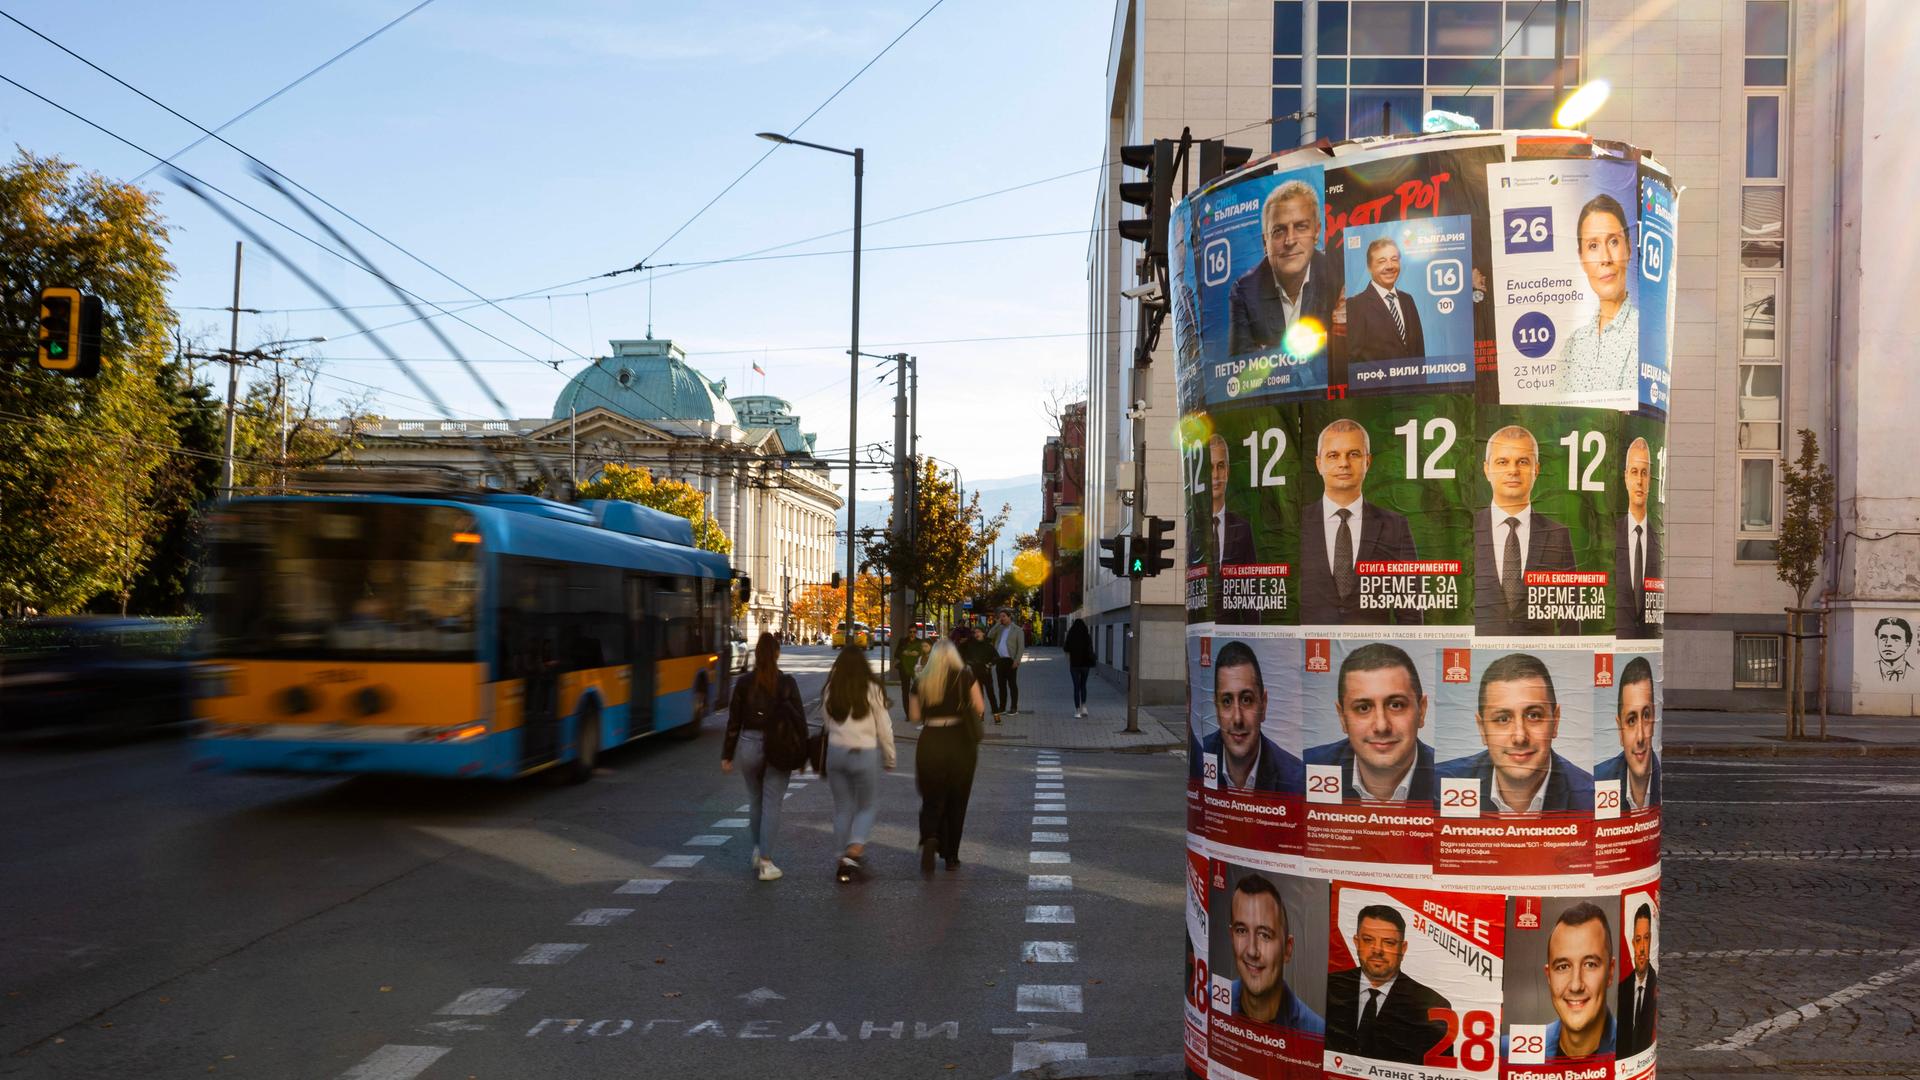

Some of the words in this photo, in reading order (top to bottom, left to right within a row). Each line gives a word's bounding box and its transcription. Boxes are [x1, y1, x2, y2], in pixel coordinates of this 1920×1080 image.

[1329, 184, 1344, 194] РУСЕ
[1215, 199, 1259, 221] БЪЛГАРИЯ
[1509, 217, 1549, 243] 26
[1209, 253, 1224, 274] 16
[1648, 244, 1660, 269] 16
[1434, 268, 1457, 286] 16
[1506, 278, 1573, 291] Елисавета
[1507, 292, 1584, 305] Белобрадова
[1519, 327, 1550, 343] 110
[1215, 360, 1246, 377] ПЕТЪР
[1249, 352, 1309, 371] МОСКОВ
[1357, 369, 1387, 381] проф.
[1390, 366, 1419, 377] ВИЛИ
[1421, 362, 1466, 375] ЛИЛКОВ
[1513, 366, 1529, 377] 23
[1531, 364, 1557, 375] МИР
[1228, 381, 1239, 392] 101
[1267, 374, 1290, 386] СОФИЯ
[1517, 379, 1555, 390] София
[1394, 417, 1457, 480] 12
[1243, 427, 1287, 488] 12
[1560, 430, 1607, 492] 12
[1223, 567, 1237, 576] СТИГА
[1238, 565, 1287, 575] ЕКСПЕРИМЕНТИ!
[1360, 563, 1385, 573] СТИГА
[1387, 563, 1458, 573] ЕКСПЕРИМЕНТИ!
[1223, 578, 1256, 595] ВРЕМЕ
[1260, 579, 1267, 595] Е
[1270, 578, 1287, 595] ЗА
[1360, 576, 1416, 594] ВРЕМЕ
[1421, 576, 1431, 594] Е
[1436, 575, 1458, 594] ЗА
[1527, 574, 1551, 583] СТИГА
[1552, 573, 1606, 583] ЕКСПЕРИМЕНТИ!
[1223, 595, 1287, 611] ВЪЗРАЖДАНЕ!
[1360, 594, 1458, 611] ВЪЗРАЖДАНЕ!
[1528, 587, 1576, 604] ВРЕМЕ
[1580, 587, 1587, 604] Е
[1590, 587, 1606, 604] ЗА
[1527, 605, 1606, 621] ВЪЗРАЖДАНЕ!
[1203, 763, 1217, 780] 28
[1309, 775, 1340, 794] 28
[1443, 789, 1478, 807] 28
[1597, 791, 1619, 809] 28
[1231, 800, 1287, 816] Атанасов
[1307, 809, 1366, 824] Атанас
[1367, 813, 1434, 826] Атанас
[1441, 825, 1504, 836] Атанас
[1506, 824, 1578, 836] Атанасов
[1595, 826, 1634, 837] Атанас
[1423, 899, 1469, 934] ВРЕМЕ
[1473, 917, 1490, 945] Е
[1413, 913, 1426, 934] ЗА
[1428, 923, 1492, 981] РЕШЕНИЯ
[1212, 984, 1230, 1005] 28
[525, 1018, 959, 1041] ПОГЛЕДНИ
[1211, 1015, 1245, 1037] Габриел
[1246, 1029, 1286, 1049] Вълков
[1423, 1007, 1495, 1072] 28
[1511, 1036, 1543, 1054] 28
[1368, 1065, 1414, 1080] Атанас
[1508, 1070, 1563, 1080] Габриел
[1564, 1067, 1607, 1080] Вълков
